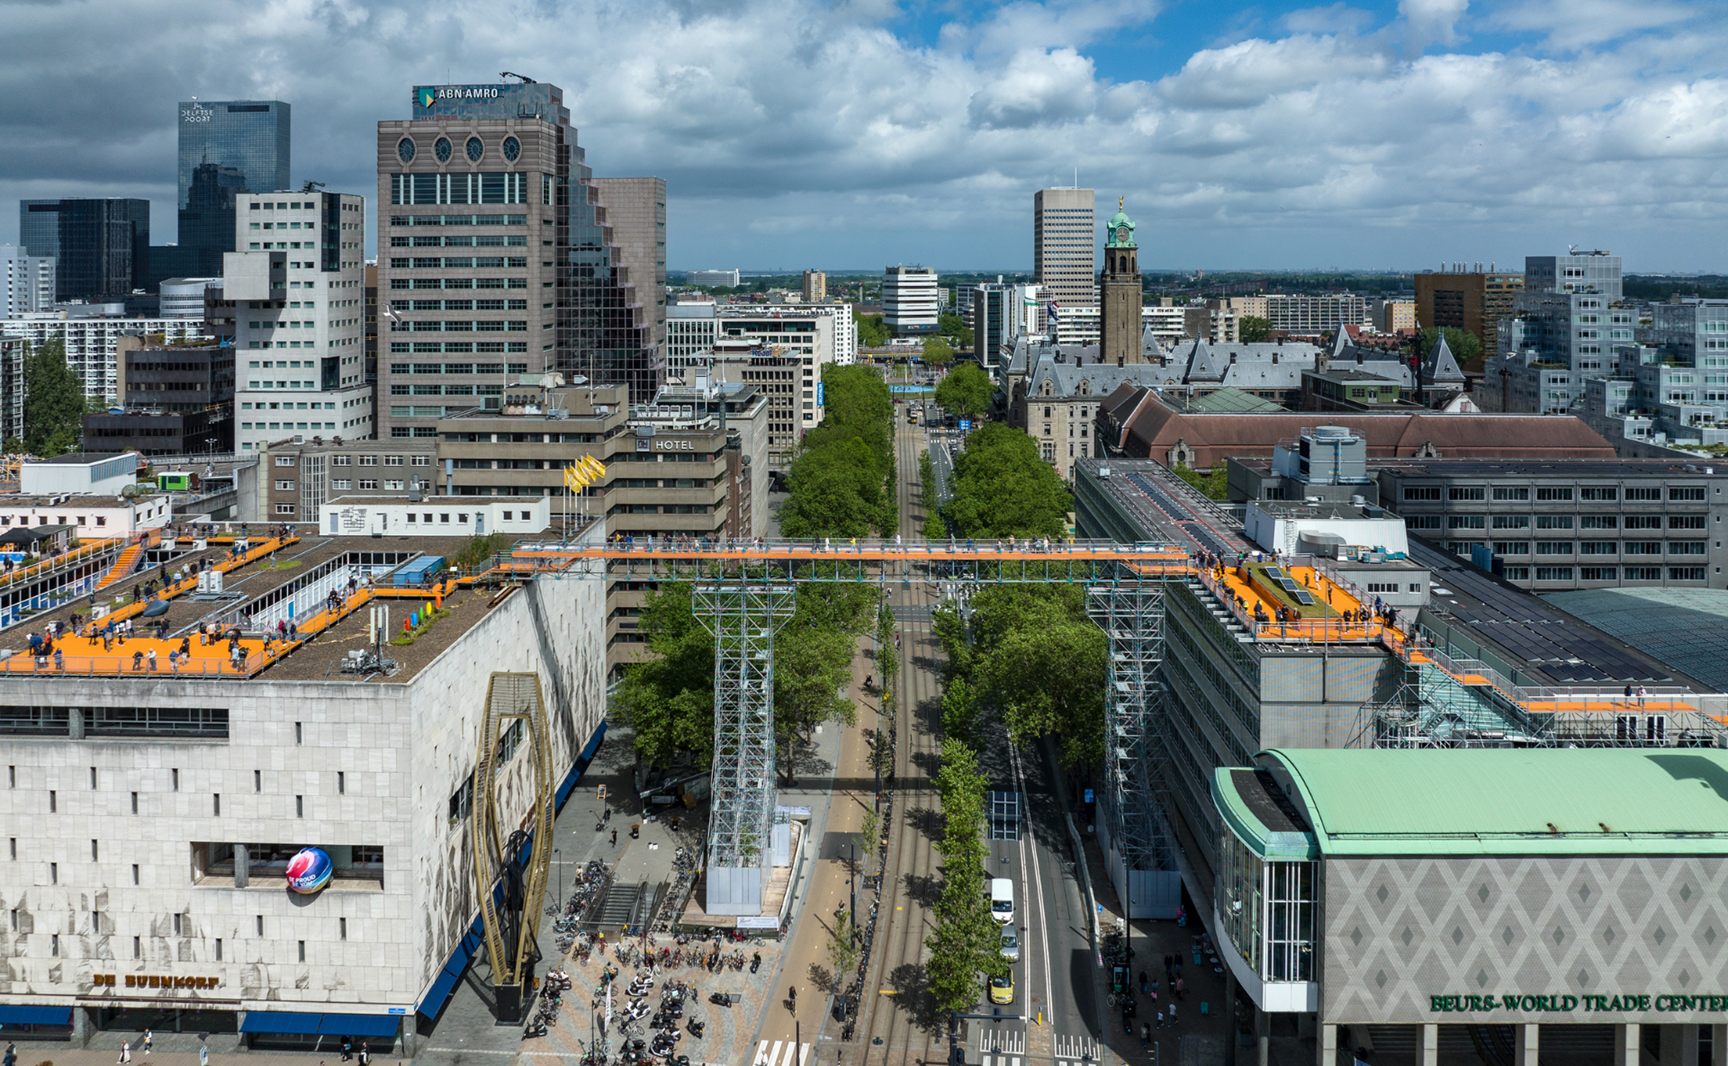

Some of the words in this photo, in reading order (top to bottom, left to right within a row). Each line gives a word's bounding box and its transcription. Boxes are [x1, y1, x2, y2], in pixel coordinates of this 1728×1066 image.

[656, 440, 694, 449] HOTEL
[93, 974, 116, 987] DE
[1430, 995, 1579, 1012] BEURS-WORLD
[1582, 994, 1652, 1012] TRADE
